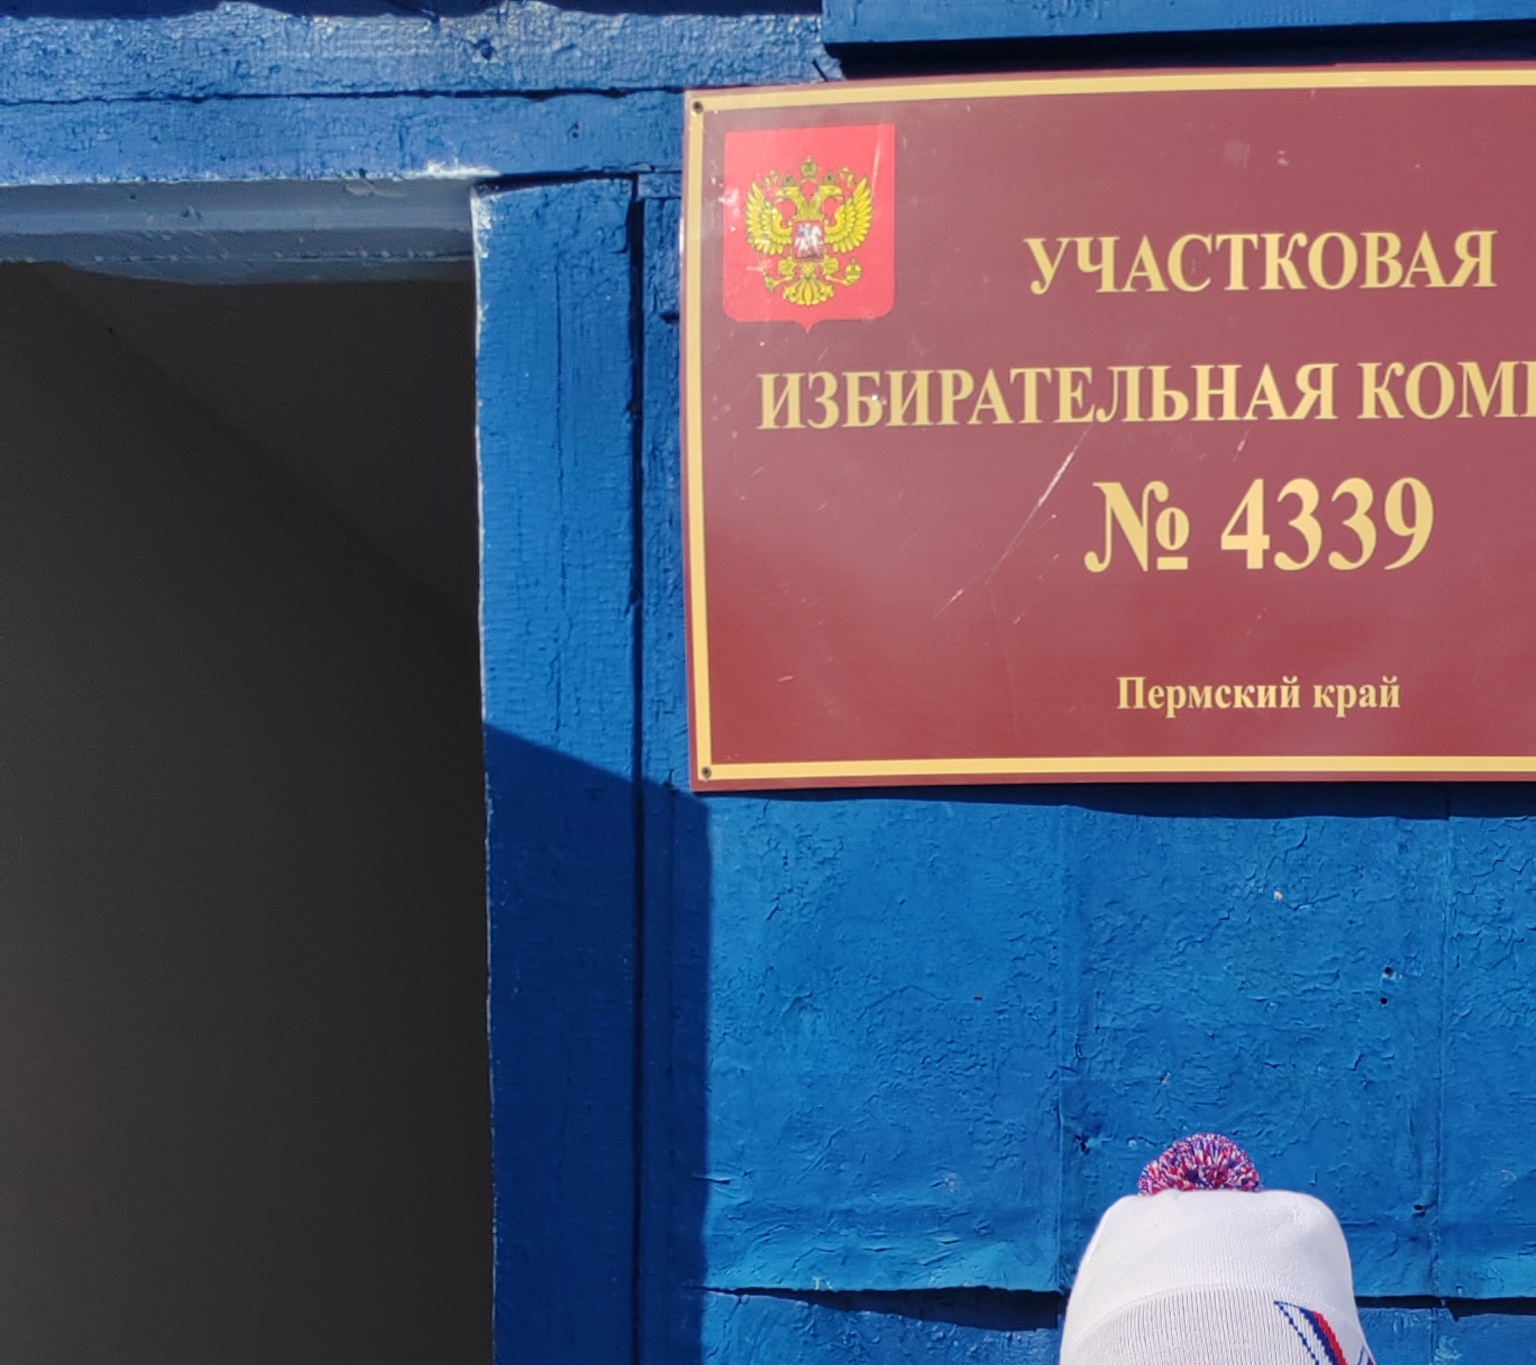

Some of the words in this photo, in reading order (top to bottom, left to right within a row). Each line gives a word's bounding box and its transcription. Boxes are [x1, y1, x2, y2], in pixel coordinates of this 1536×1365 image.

[1024, 229, 1498, 296] УЧАСТКОВАЯ
[756, 361, 1339, 430] ИЗБИРАТЕЛЬНАЯ
[1084, 480, 1191, 574] №
[1220, 477, 1435, 571] 4339
[1115, 674, 1302, 720] Пермский
[1312, 675, 1401, 719] край
